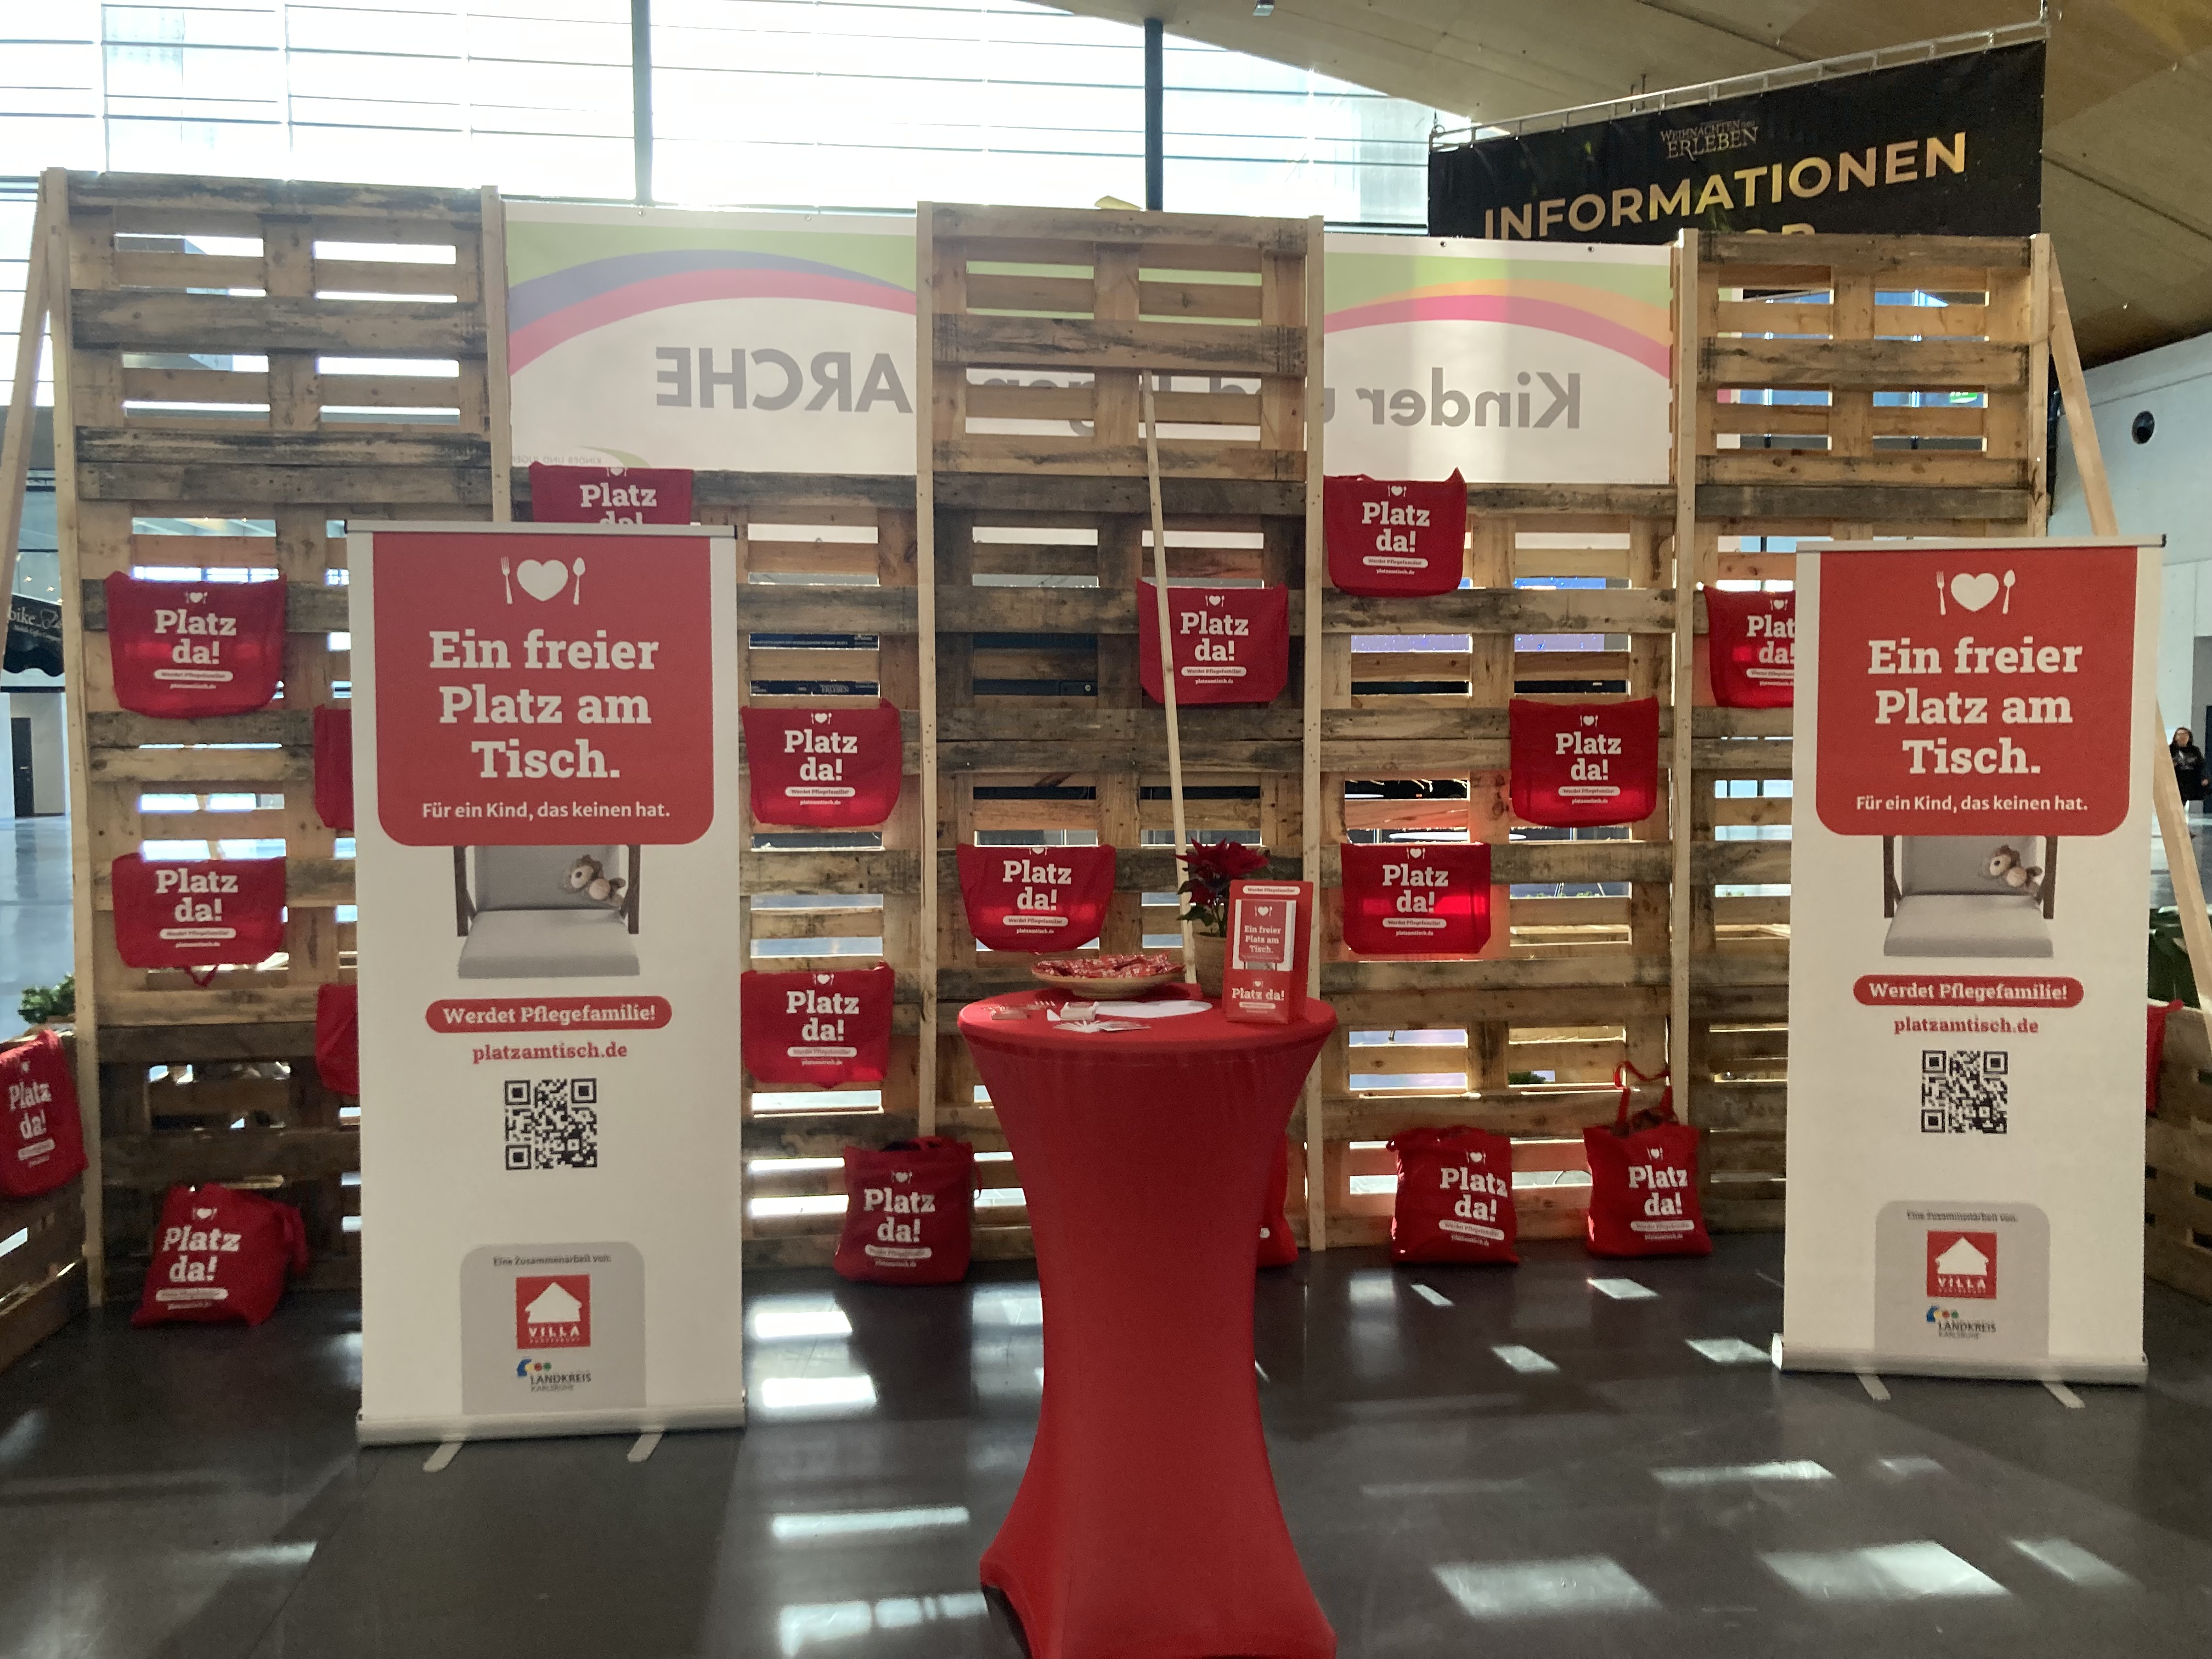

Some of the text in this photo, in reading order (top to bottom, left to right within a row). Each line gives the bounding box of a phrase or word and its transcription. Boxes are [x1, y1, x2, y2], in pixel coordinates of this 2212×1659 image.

[1667, 126, 1759, 161] ERLEBEN
[1485, 132, 1965, 240] INFORMATIONEN
[580, 483, 657, 507] Platz
[1362, 501, 1430, 527] Platz
[1376, 528, 1416, 553] da!
[155, 609, 236, 636] Platz
[1180, 611, 1249, 636] Platz
[1746, 614, 1795, 638] Plat
[173, 638, 219, 664] da!
[430, 628, 659, 670] Ein freier
[1194, 638, 1235, 661] da!
[1758, 641, 1795, 664] da!
[1868, 636, 2083, 674] Ein freier
[439, 684, 652, 724] Platz am
[1875, 688, 2073, 724] Platz am
[785, 729, 857, 753] Platz
[1556, 731, 1621, 754] Platz
[471, 738, 620, 778] Tisch.
[1902, 737, 2040, 774] Tisch.
[800, 757, 842, 781] da!
[1571, 758, 1609, 781] da!
[423, 802, 670, 821] Für ein Kind, das keinen hat.
[1857, 795, 2088, 814] Für ein Kind, das keinen hat.
[156, 868, 238, 894] Platz
[1003, 859, 1071, 884] Platz
[1383, 864, 1448, 887] Platz
[175, 897, 222, 922] da!
[1017, 886, 1057, 911] da!
[1396, 889, 1435, 913] da!
[1245, 935, 1265, 943] Platz
[1259, 926, 1282, 934] freier
[1249, 945, 1273, 953] Tisch.
[786, 990, 859, 1014] Platz
[1232, 987, 1284, 1001] Platz da!
[1869, 983, 2068, 1002] Werdet Pflegefamilie!
[443, 1003, 656, 1026] Werdet Pflegefamilie!
[1894, 1016, 2039, 1035] platzamtisch.de
[802, 1017, 844, 1041] da!
[473, 1041, 627, 1064] platzamtisch.de
[9, 1081, 52, 1112] Platz
[20, 1109, 47, 1139] da!
[1440, 1167, 1508, 1198] Platz
[1628, 1164, 1688, 1189] Platz
[864, 1187, 935, 1214] Platz
[1455, 1194, 1497, 1222] da!
[1644, 1192, 1683, 1216] da!
[163, 1224, 242, 1252] Platz
[877, 1216, 921, 1243] da!
[169, 1255, 218, 1282] da!
[1938, 1278, 1986, 1289] VILLA
[529, 1326, 580, 1337] VILLA
[1938, 1321, 1997, 1333] LANDKREIS
[530, 1373, 591, 1384] LANDKREIS
